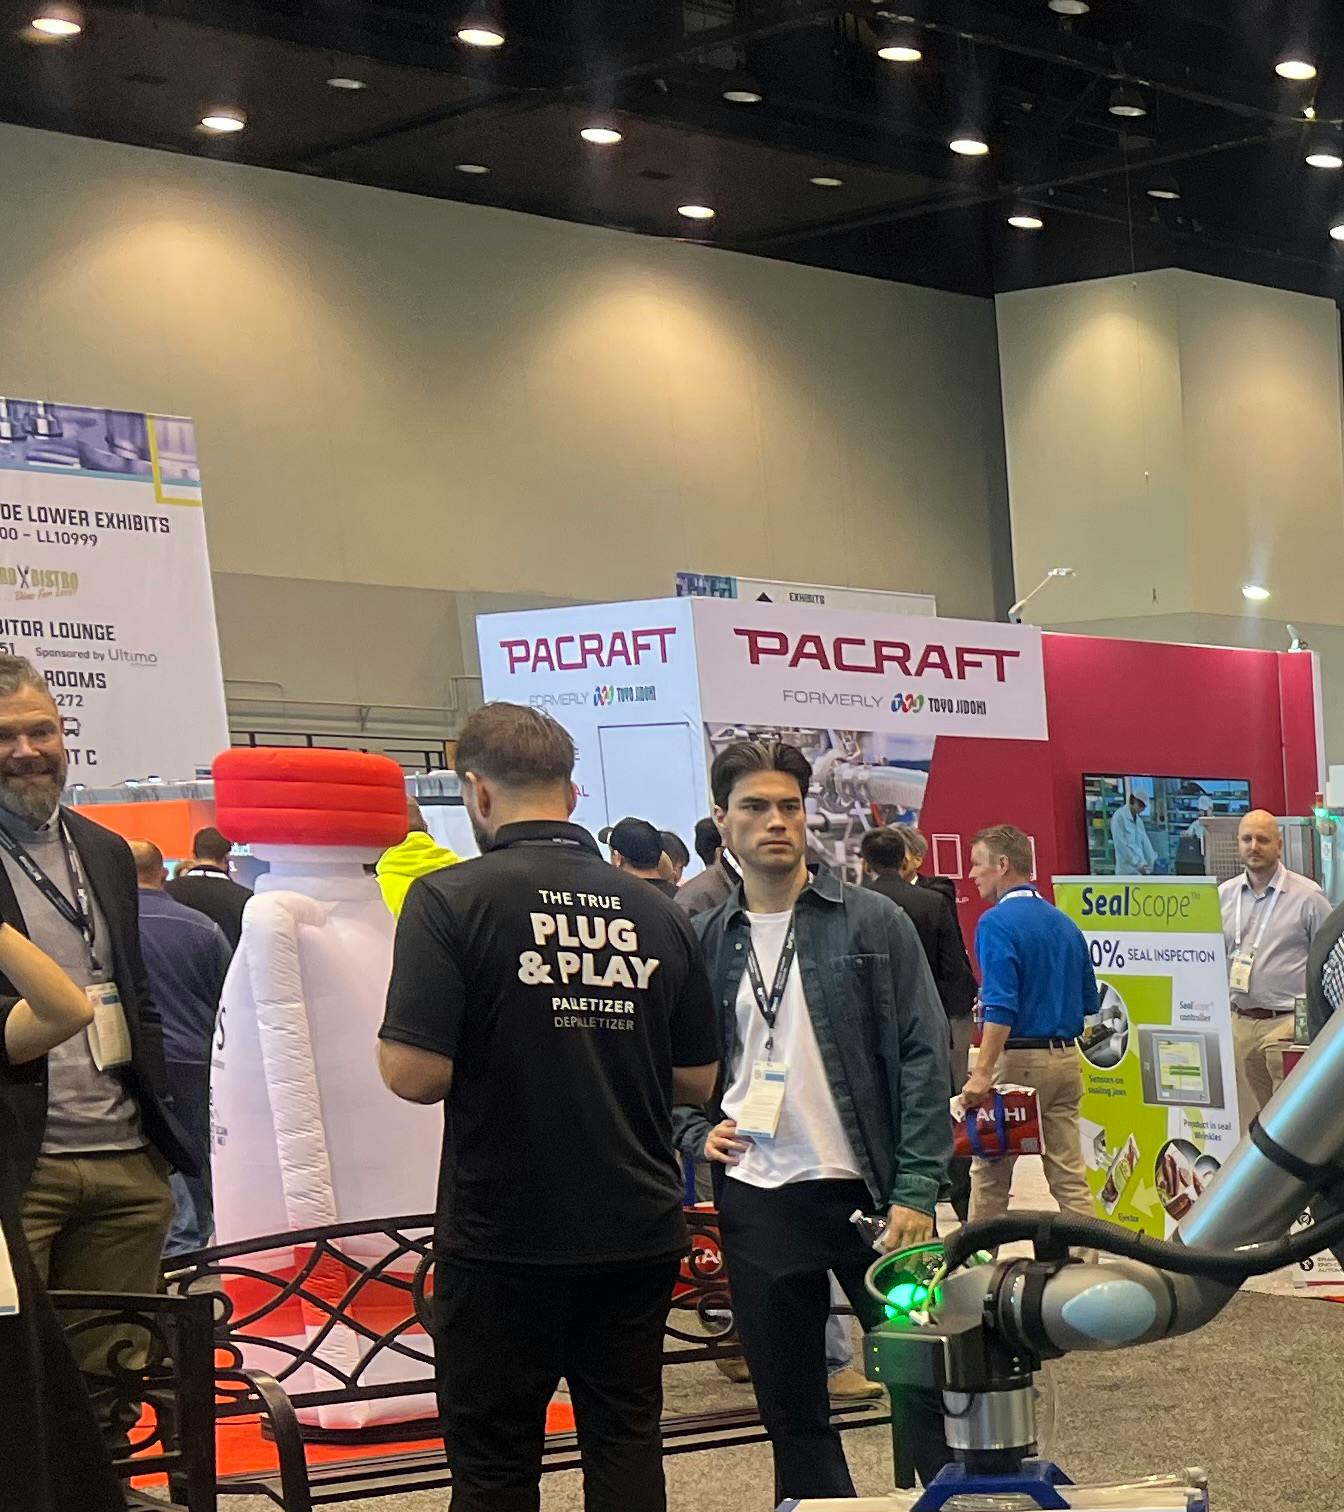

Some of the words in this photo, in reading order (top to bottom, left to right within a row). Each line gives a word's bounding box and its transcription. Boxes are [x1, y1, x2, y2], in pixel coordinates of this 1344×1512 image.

[27, 505, 90, 528] LOWER
[94, 511, 171, 534] EXHIBITS
[36, 529, 98, 547] LL10999
[31, 568, 79, 590] BISTRO
[49, 620, 116, 642] LOUNGE
[34, 647, 90, 660] Sponsored
[92, 650, 105, 662] by
[499, 626, 677, 675] PACRAFT
[733, 627, 1020, 683] PACRAFT
[44, 670, 107, 689] ROOMS
[783, 689, 884, 709] FORMERLY
[928, 697, 953, 713] TOYO
[538, 888, 572, 907] THE
[577, 893, 621, 911] TRUE
[529, 912, 639, 952] PLUG
[1127, 948, 1151, 961] SEAL
[1154, 949, 1215, 963] INSPECTION
[517, 950, 554, 986] &
[557, 951, 660, 990] PLAY
[1217, 1121, 1232, 1132] seal
